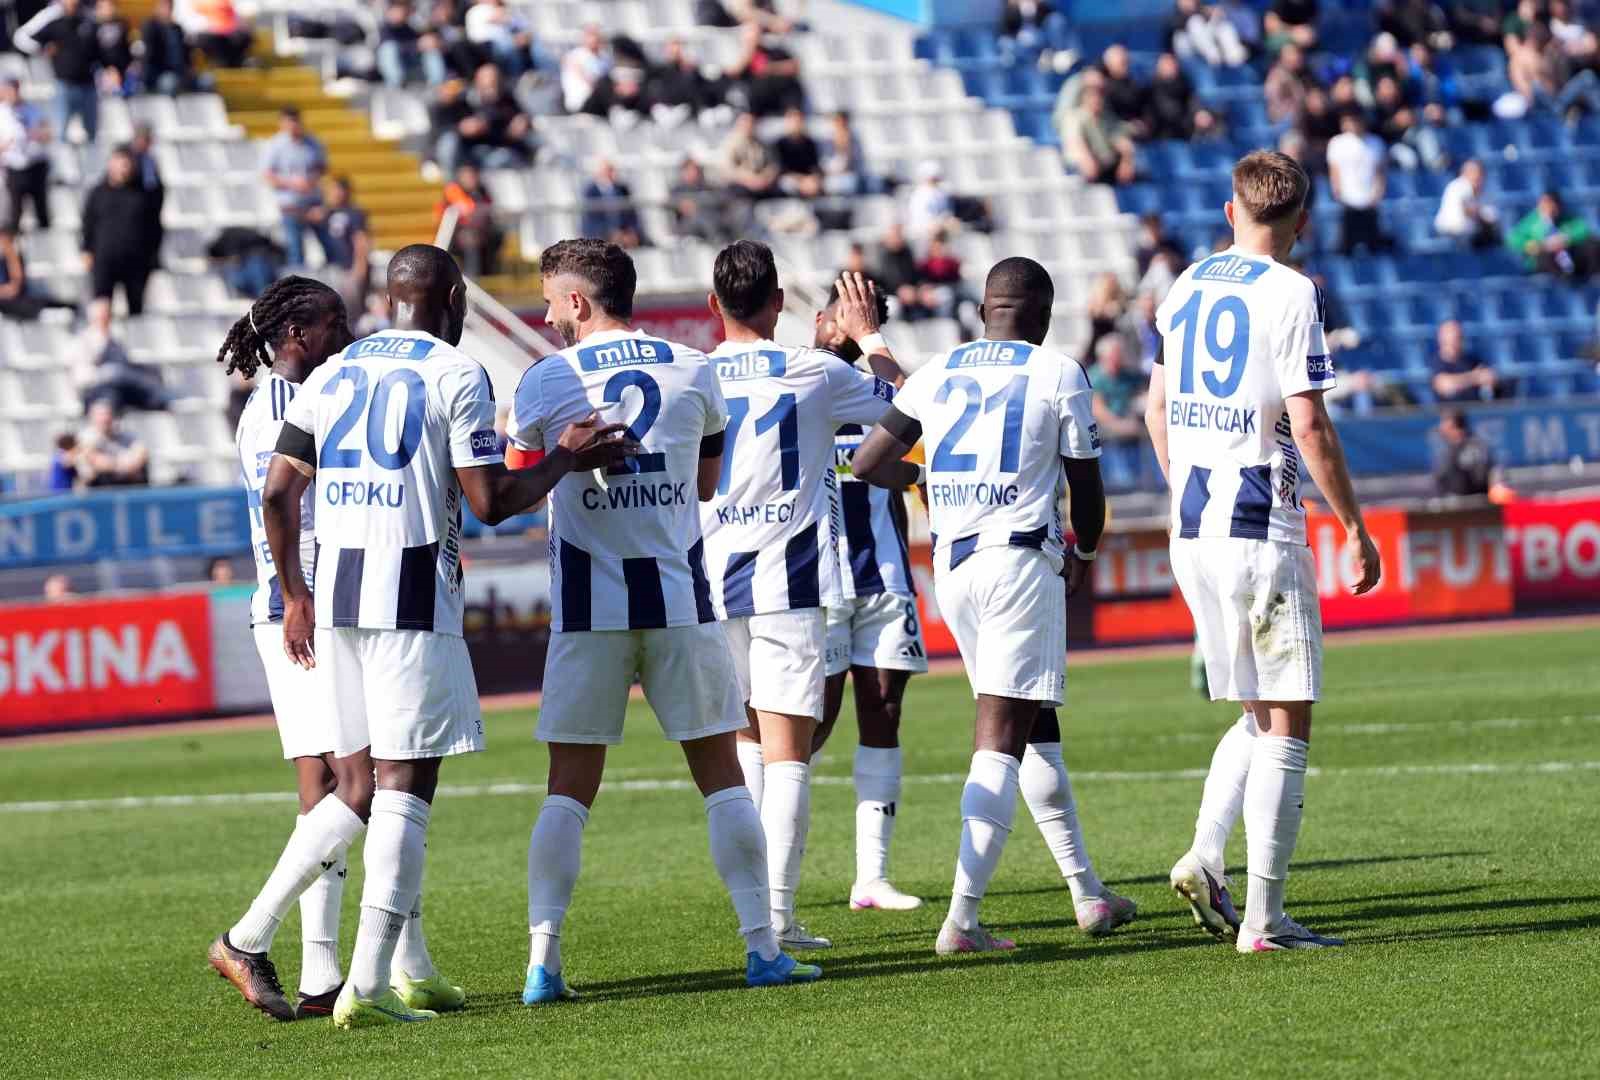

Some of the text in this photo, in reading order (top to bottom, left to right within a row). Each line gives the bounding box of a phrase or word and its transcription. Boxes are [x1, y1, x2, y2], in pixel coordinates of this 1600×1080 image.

[594, 339, 656, 363] mila
[1169, 290, 1250, 399] 19
[319, 365, 426, 470] 20
[603, 370, 666, 475] 2
[717, 393, 800, 496] 71
[931, 374, 1029, 473] 21
[326, 481, 404, 508] OFOKU
[582, 480, 686, 510] C.WİNCK
[903, 601, 918, 637] 8
